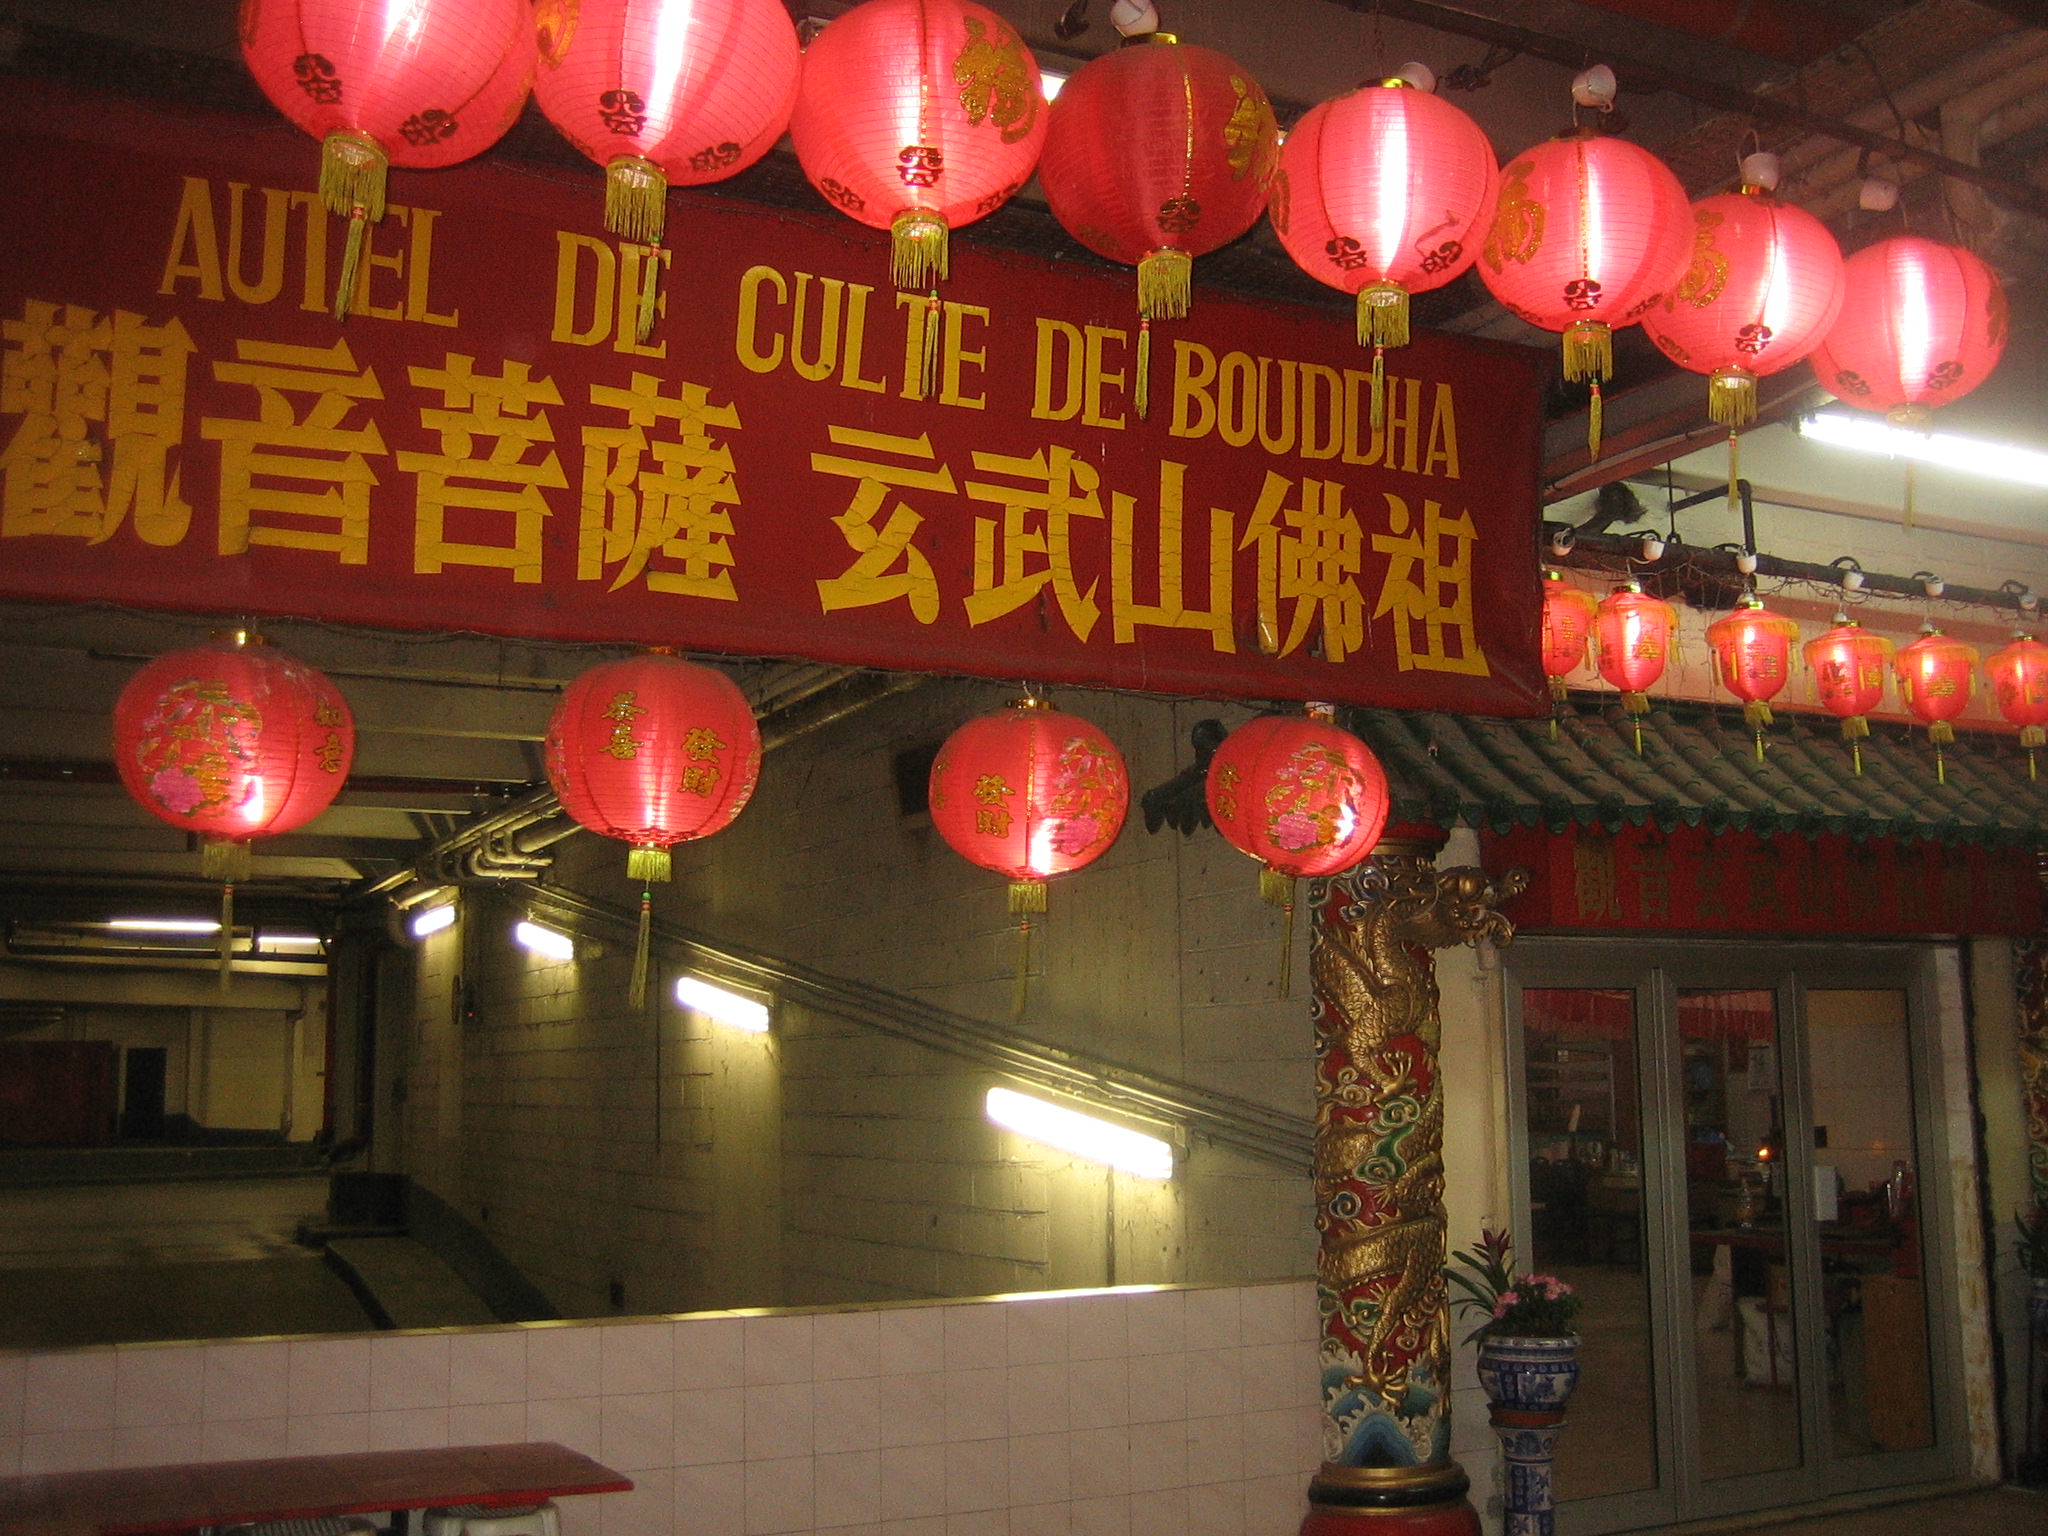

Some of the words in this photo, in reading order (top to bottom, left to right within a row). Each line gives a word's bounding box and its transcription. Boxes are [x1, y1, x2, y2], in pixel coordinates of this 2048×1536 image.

[0, 298, 744, 601] 觀音菩薩
[809, 423, 1491, 677] 玄武山佛祖
[156, 176, 459, 328] AUTEL
[551, 230, 672, 359] DE
[735, 264, 990, 411] CULTE
[1032, 317, 1127, 430] DE
[1169, 338, 1462, 480] BOUDDHA
